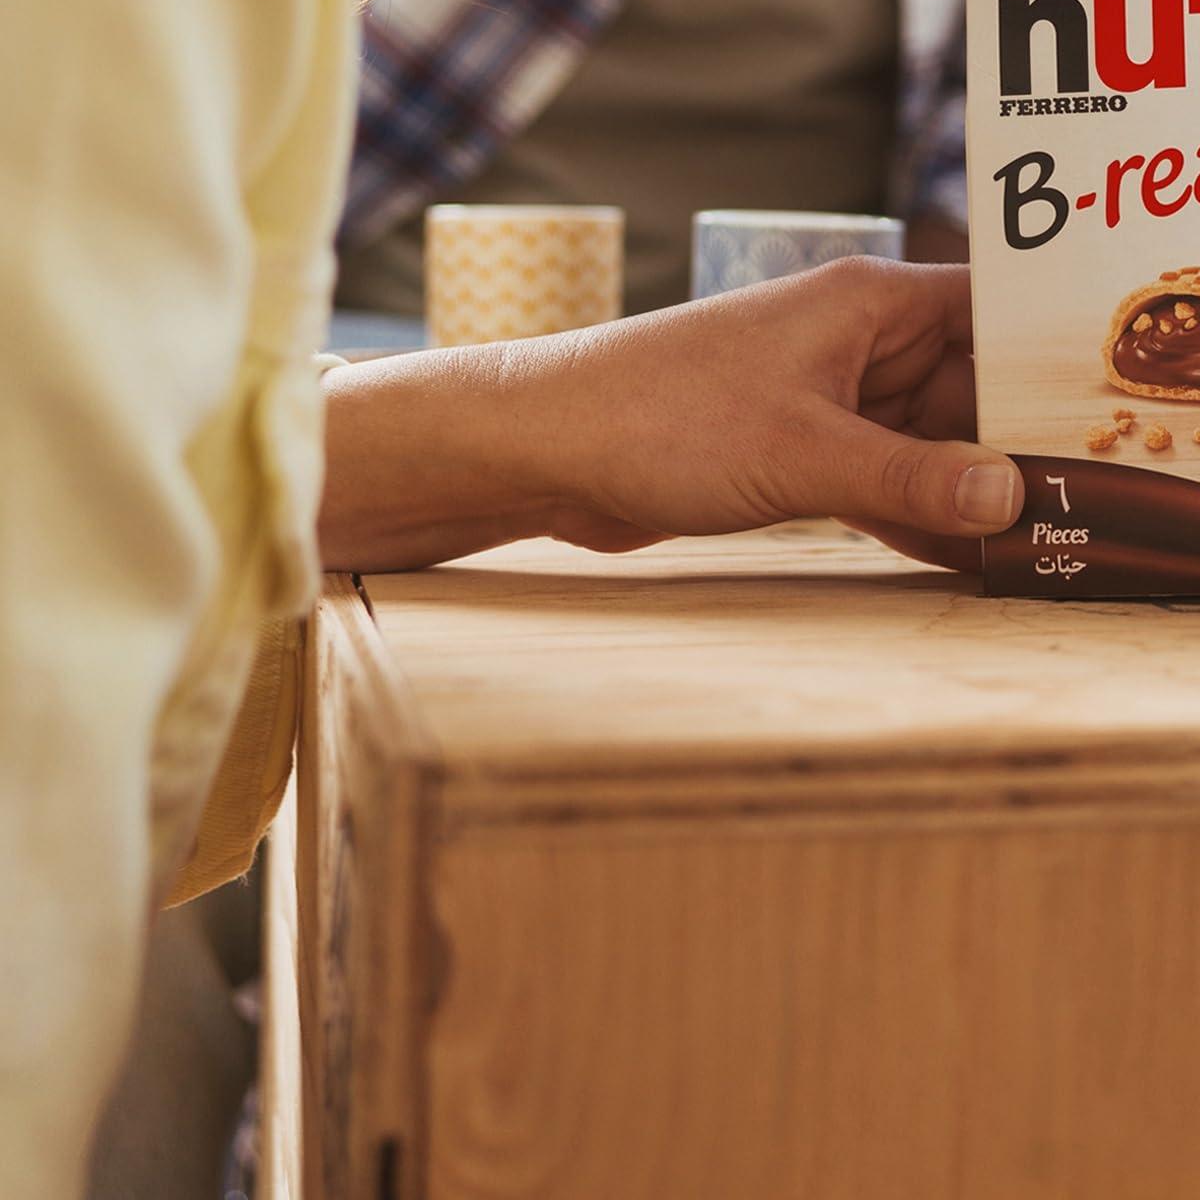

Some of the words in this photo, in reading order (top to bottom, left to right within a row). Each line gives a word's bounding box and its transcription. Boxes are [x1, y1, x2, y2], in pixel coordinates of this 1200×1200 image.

[999, 95, 1128, 117] FERRERO
[1046, 475, 1071, 513] ٦
[1032, 523, 1089, 545] Pieces
